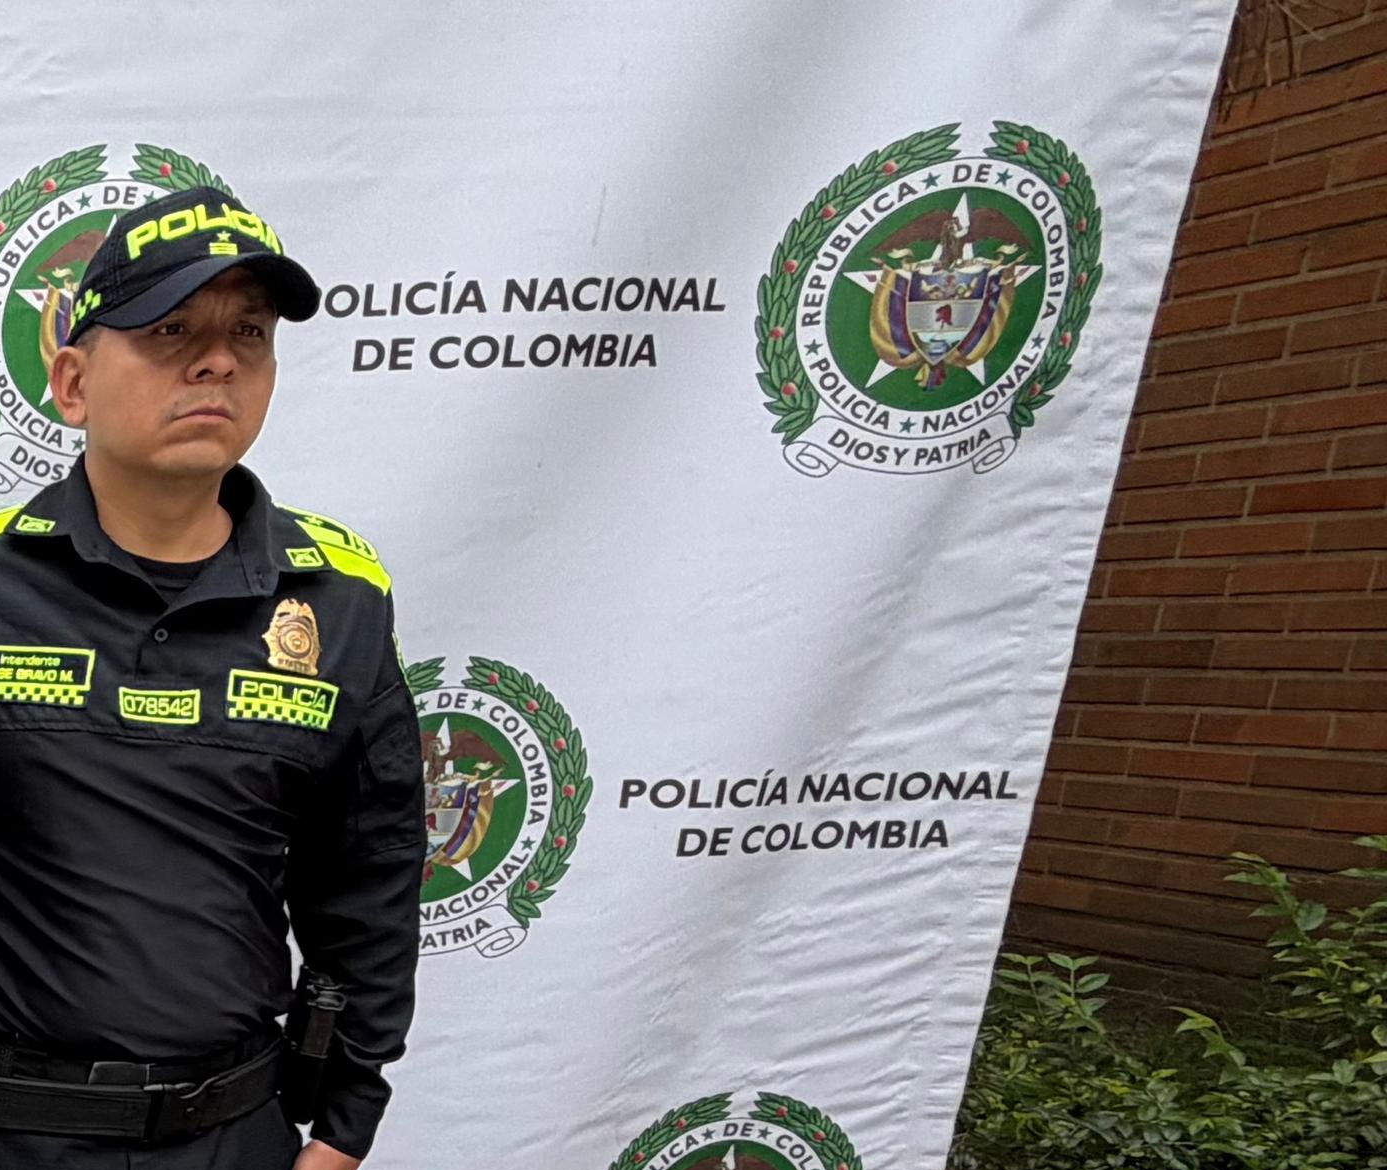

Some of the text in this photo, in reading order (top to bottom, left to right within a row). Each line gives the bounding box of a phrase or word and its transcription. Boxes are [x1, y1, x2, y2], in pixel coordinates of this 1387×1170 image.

[103, 186, 138, 205] DE
[127, 203, 281, 260] POLICÍA
[952, 164, 992, 183] DE
[1016, 179, 1065, 319] COLOMBIA
[503, 277, 725, 312] NACIONAL
[353, 334, 656, 371] DE COLOMBIA
[809, 352, 1040, 433] POLICÍA NACIONAL
[9, 445, 67, 481] DIOS
[827, 428, 991, 466] DIOS Y PATRIA
[123, 695, 193, 717] 078542
[241, 681, 326, 711] POLICÍA
[437, 692, 547, 826] DE COLOMBIA
[619, 769, 1017, 808] POLICÍA NACIONAL
[676, 820, 948, 857] DE COLOMBIA
[722, 1122, 755, 1137] DE
